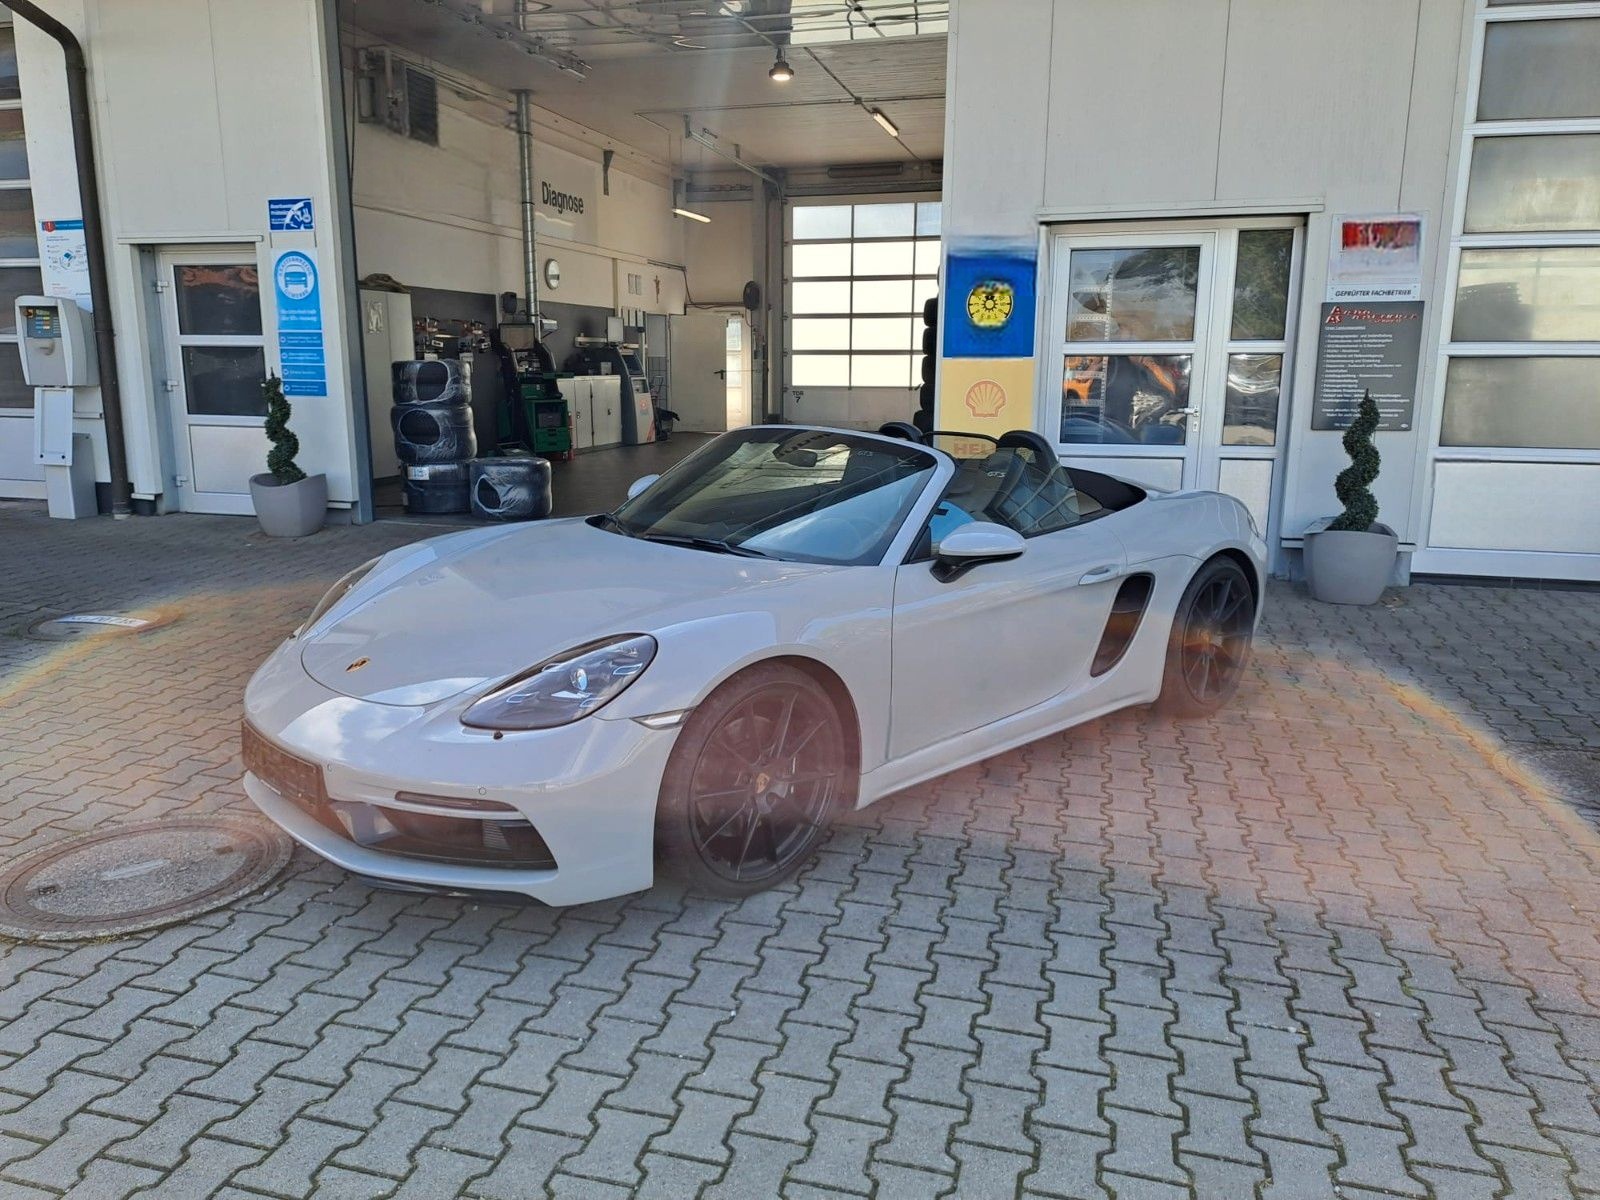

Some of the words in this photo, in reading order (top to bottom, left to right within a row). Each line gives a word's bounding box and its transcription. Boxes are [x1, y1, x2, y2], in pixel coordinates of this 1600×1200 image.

[542, 181, 584, 215] Diagnose
[1335, 289, 1370, 297] GEPRÜFTER
[1371, 289, 1412, 297] FACHBETRIEB
